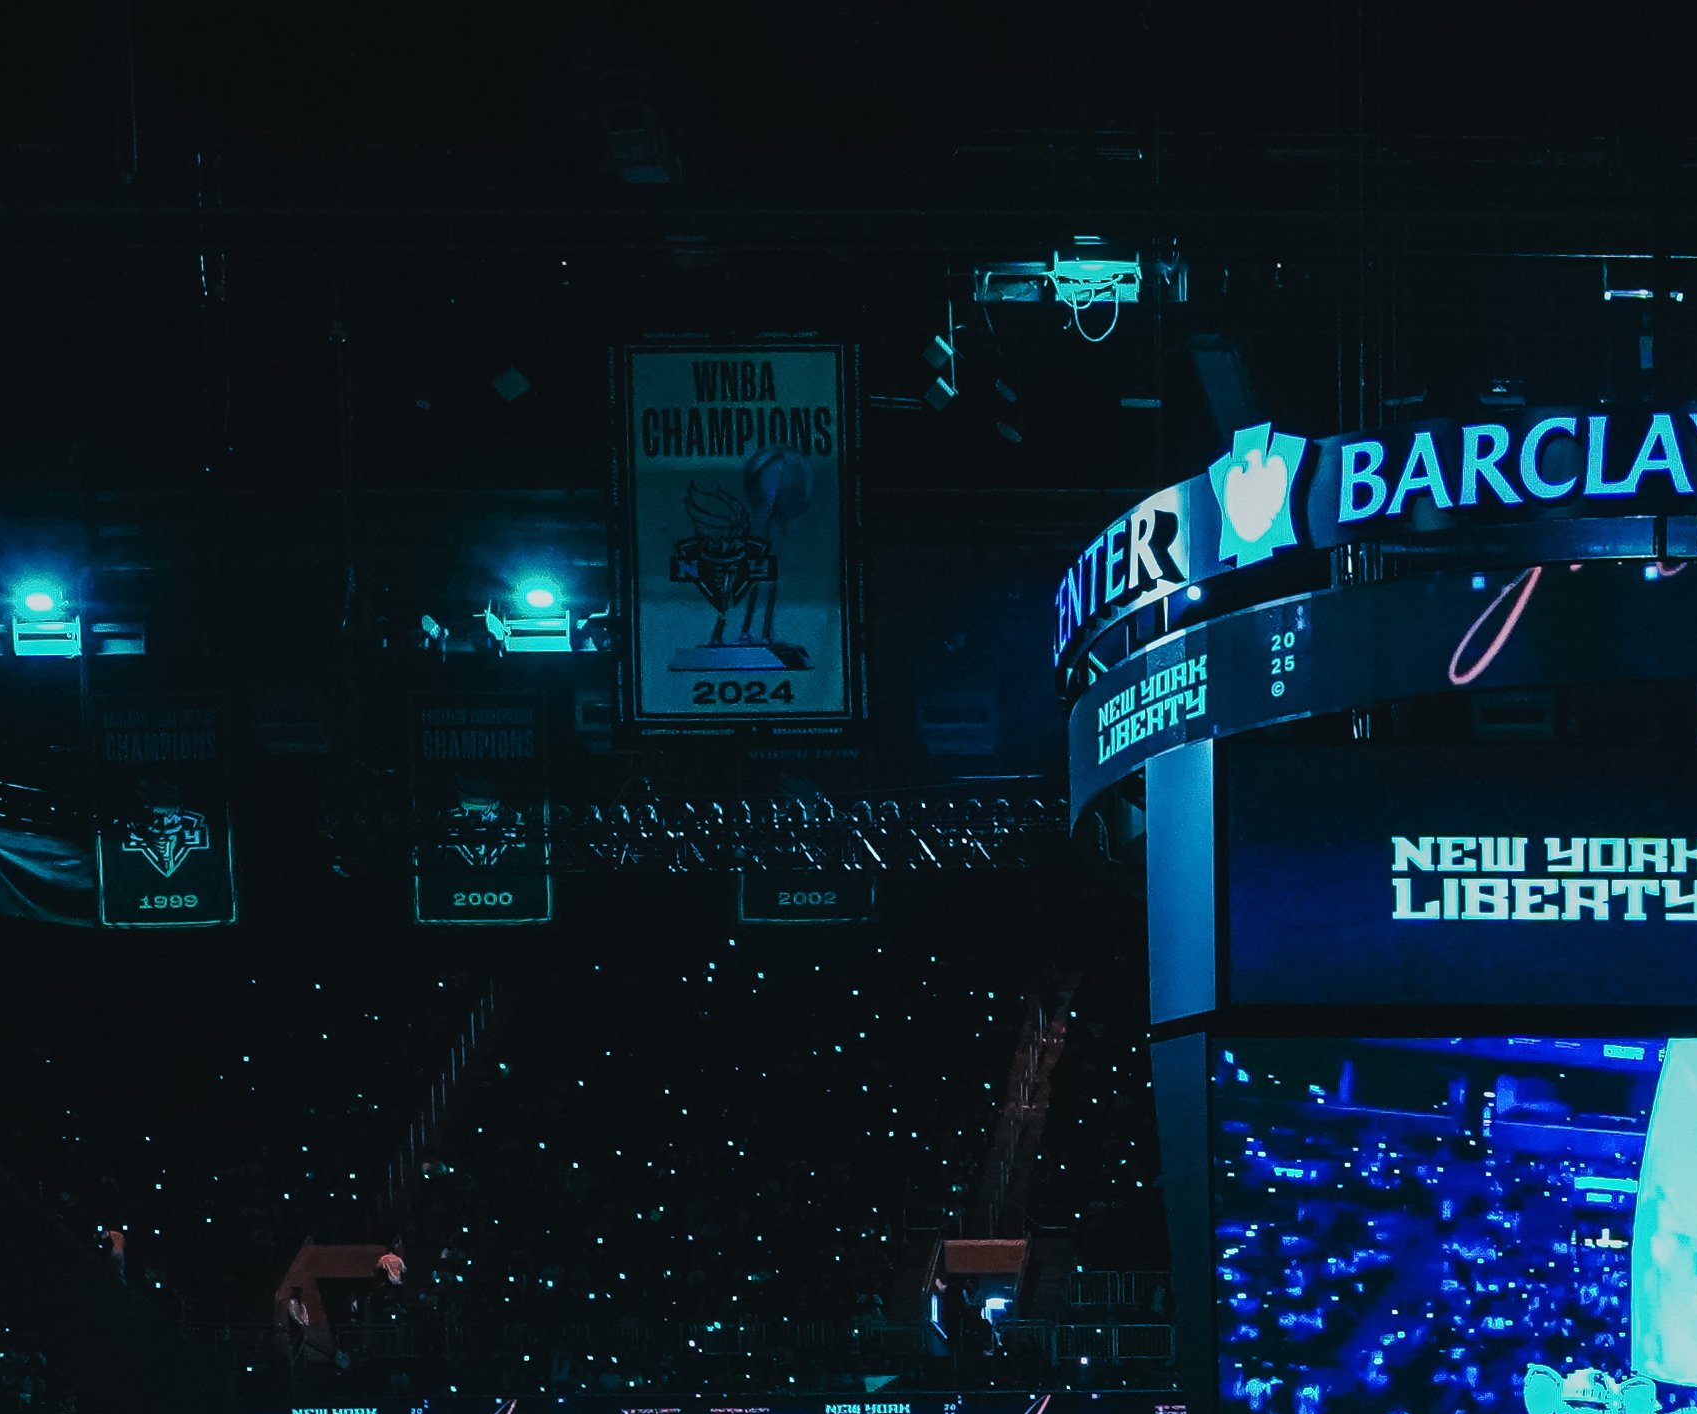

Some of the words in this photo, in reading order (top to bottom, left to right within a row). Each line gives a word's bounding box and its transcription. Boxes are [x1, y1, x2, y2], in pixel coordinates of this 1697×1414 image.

[690, 360, 776, 402] WNBA
[642, 407, 832, 456] CHAMPIONS
[1271, 632, 1295, 652] 20
[1271, 654, 1295, 674] 25
[692, 680, 796, 704] 2024
[1098, 685, 1136, 733] NEW
[1140, 654, 1207, 705] YORK
[1098, 684, 1207, 765] LIBERTY
[422, 729, 536, 759] CHAMPIONS
[1391, 836, 1528, 872] NEW
[139, 893, 199, 909] 1999
[453, 892, 513, 906] 2000
[777, 891, 838, 905] 2002
[825, 1403, 860, 1414] NEW
[864, 1403, 910, 1414] YORK
